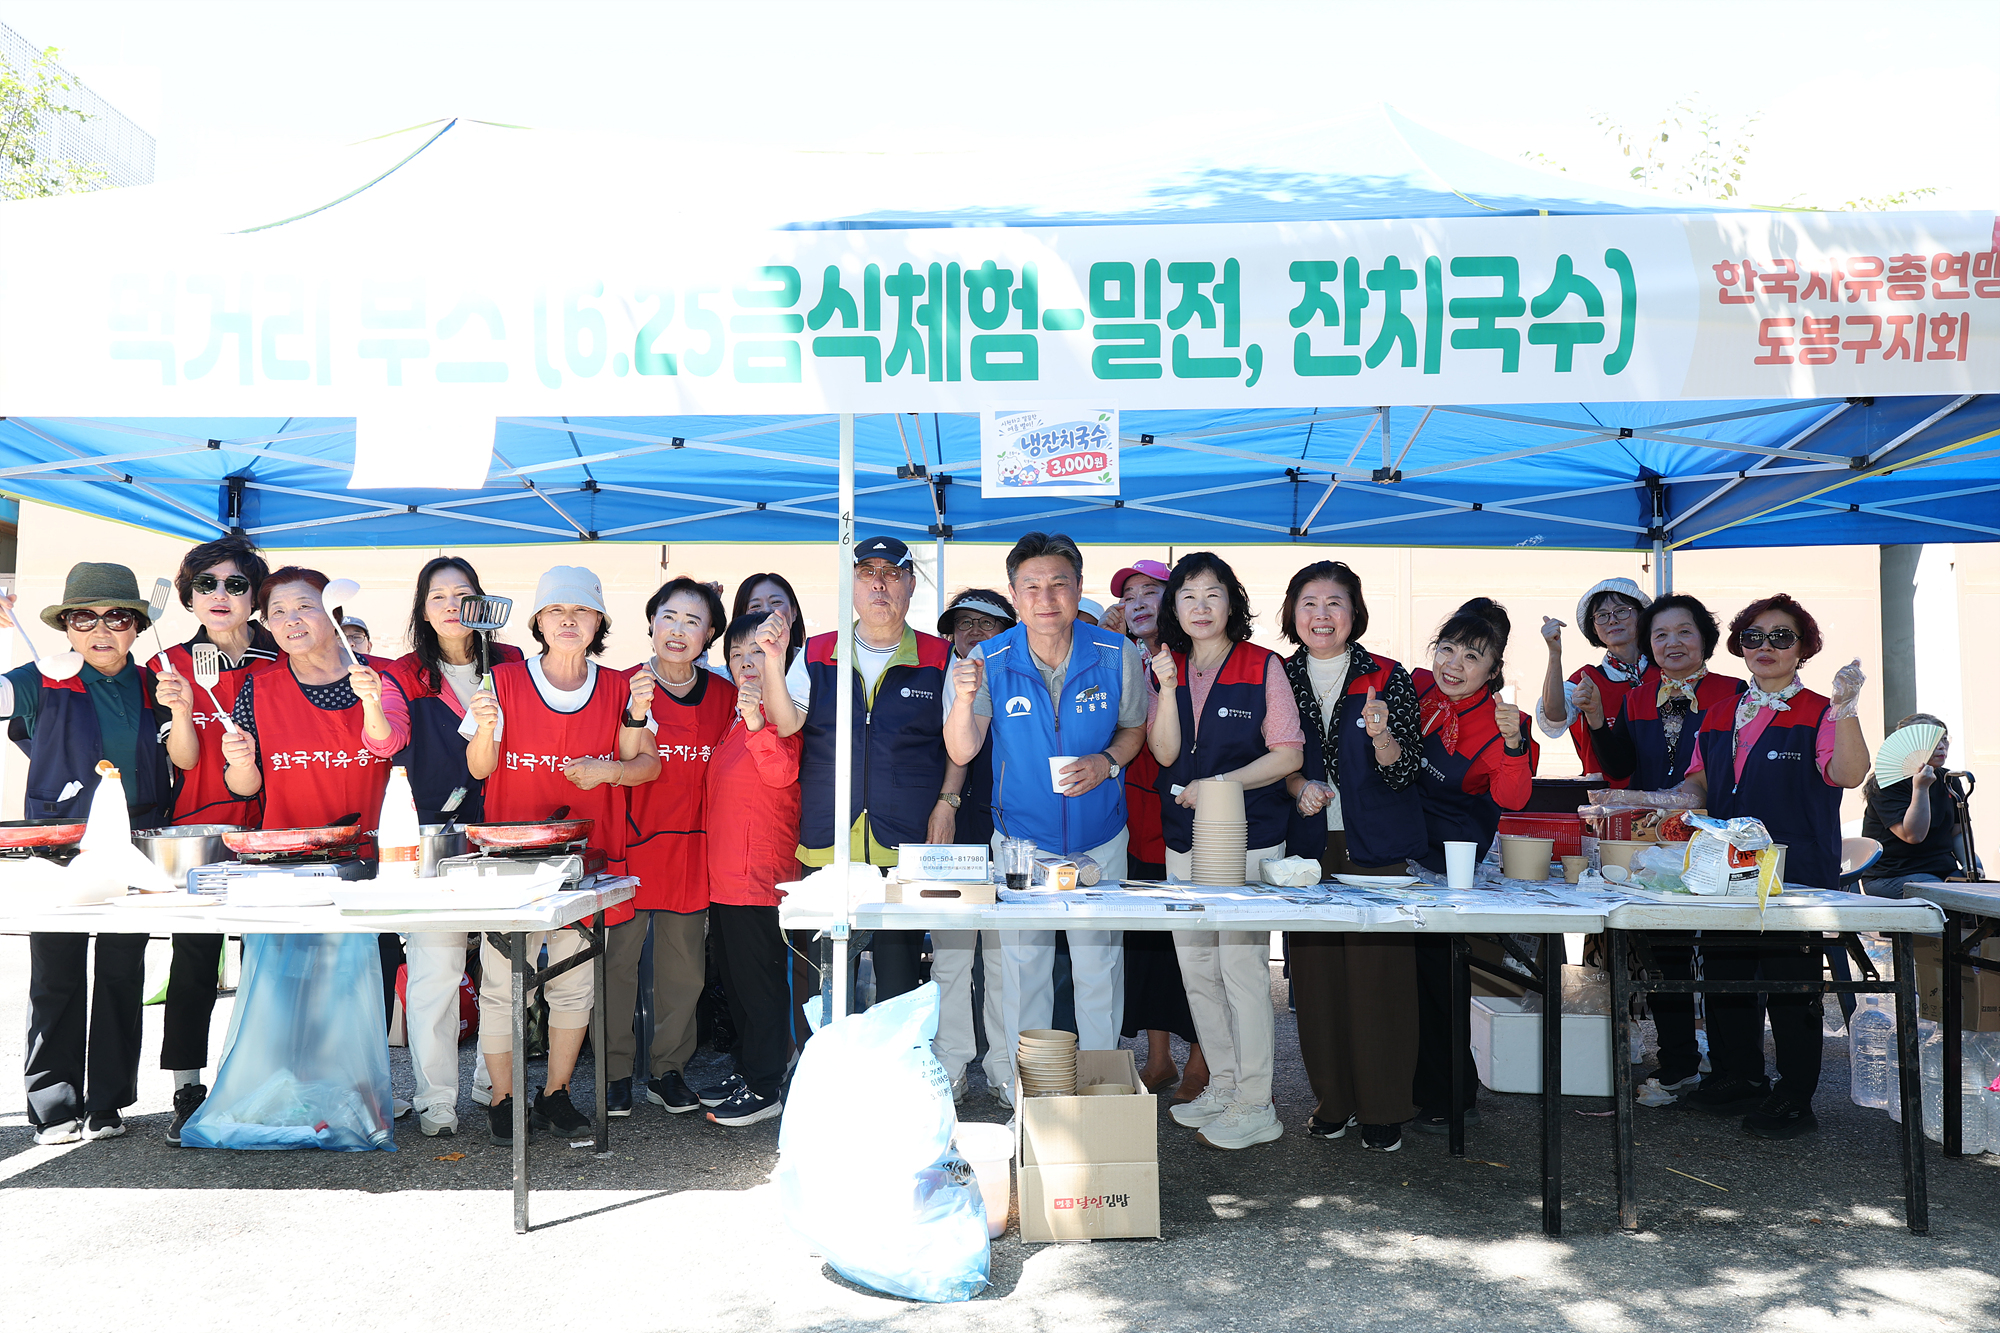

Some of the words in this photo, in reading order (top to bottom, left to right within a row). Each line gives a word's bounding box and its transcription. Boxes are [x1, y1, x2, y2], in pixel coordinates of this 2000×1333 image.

[1712, 250, 2000, 304] 한국자유총연맹
[357, 276, 509, 386] 부스
[1288, 248, 1637, 377] 잔치국수)
[1753, 311, 1970, 365] 도봉구지회
[1020, 424, 1108, 458] 냉잔치국수
[1050, 453, 1104, 476] 3,000원
[270, 748, 392, 771] 한국자유총
[1075, 1193, 1131, 1210] 달인김밥
